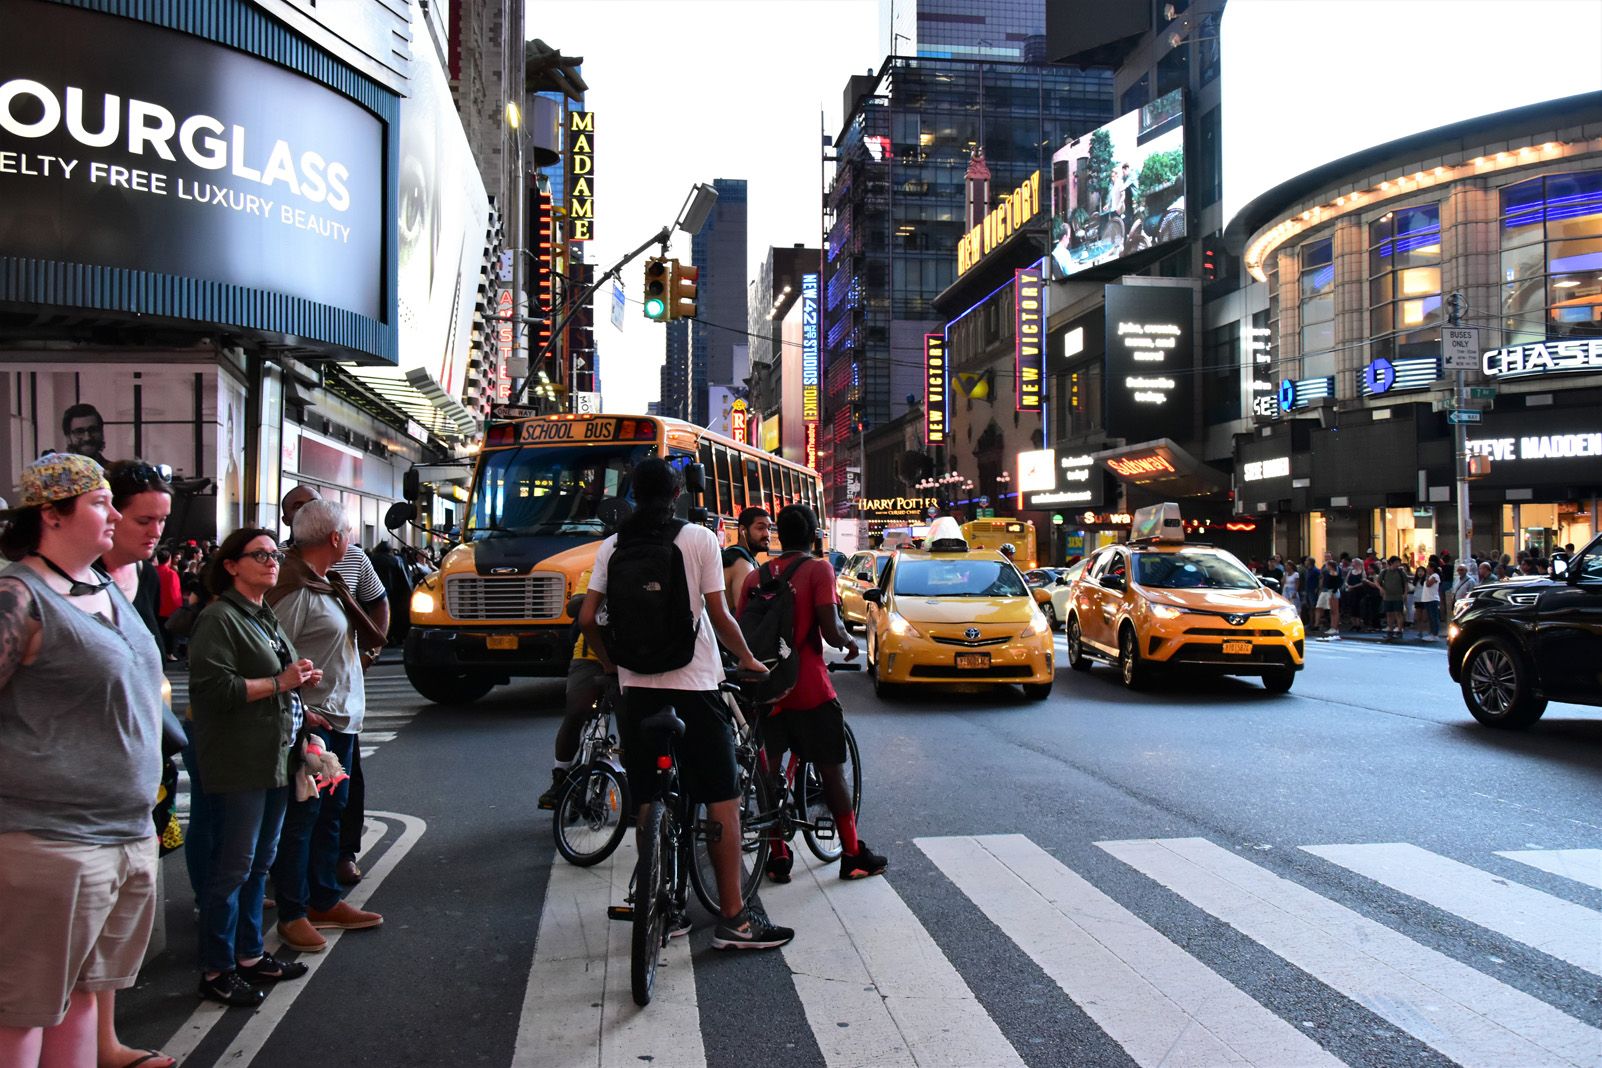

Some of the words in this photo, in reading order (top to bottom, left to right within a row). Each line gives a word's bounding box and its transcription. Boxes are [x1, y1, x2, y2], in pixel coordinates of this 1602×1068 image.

[0, 78, 350, 211] OURGLASS
[571, 112, 594, 240] MADAME
[90, 162, 167, 195] FREE
[178, 179, 274, 218] LUXURY
[281, 206, 351, 243] BEAUTY
[957, 223, 982, 277] NEW
[983, 170, 1040, 254] VICTORY
[803, 274, 817, 298] NEW
[1021, 274, 1039, 356] VICTORY
[803, 340, 818, 384] STUDIOS
[928, 338, 943, 402] VICTORY
[1482, 340, 1602, 376] CHASE
[1022, 366, 1039, 406] NEW
[497, 408, 512, 416] ONE
[518, 409, 533, 417] WAY
[523, 422, 575, 441] SCHOOL
[584, 421, 613, 438] BUS
[929, 409, 943, 441] NEW
[1520, 432, 1602, 459] MADDEN
[1106, 455, 1175, 476] Subway
[858, 498, 895, 511] HARRY
[896, 497, 940, 510] POTTER
